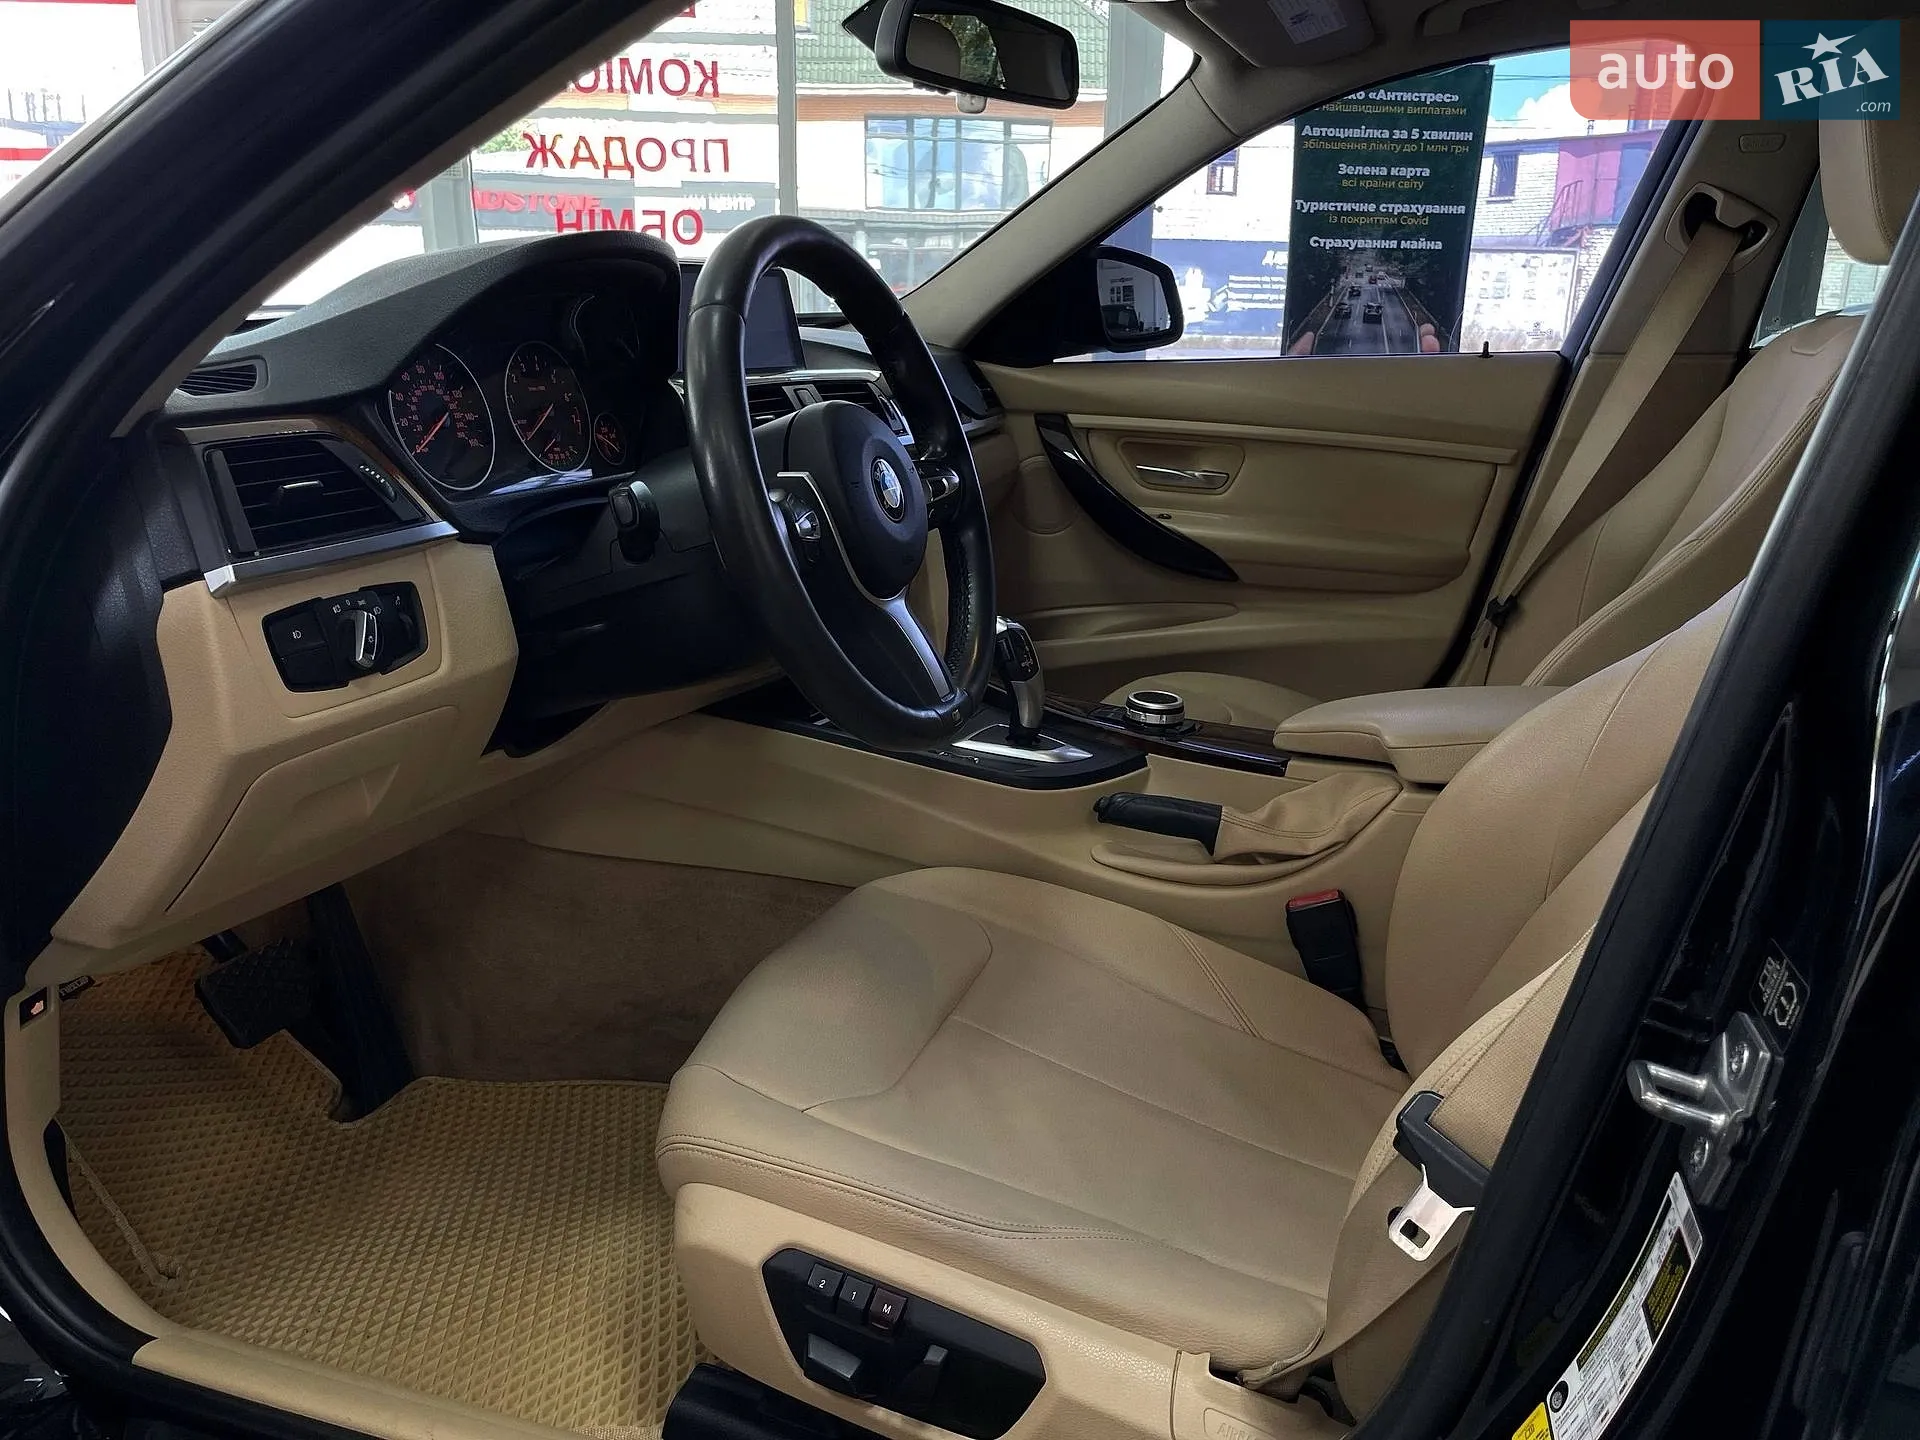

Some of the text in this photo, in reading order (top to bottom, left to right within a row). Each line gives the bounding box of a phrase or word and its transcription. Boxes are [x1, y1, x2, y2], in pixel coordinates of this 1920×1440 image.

[1368, 89, 1459, 104] «Антистрес»
[1407, 106, 1467, 116] виплатами
[1301, 124, 1473, 141] Автоцивілка за 5 хвилин
[1303, 138, 1368, 150] збільшення
[1369, 140, 1401, 153] ліміту
[1403, 143, 1418, 153] до
[1426, 145, 1448, 153] млн
[1450, 145, 1469, 154] грн
[1338, 164, 1431, 179] Зелена карта
[1341, 178, 1424, 190] всі країни світу
[1295, 199, 1466, 216] Туристичне страхування
[1340, 215, 1398, 227] покриттям
[1400, 215, 1429, 226] Covid
[1309, 236, 1443, 251] Страхування майна
[818, 1279, 826, 1289] 2
[851, 1291, 857, 1301] 1
[883, 1303, 892, 1315] M
